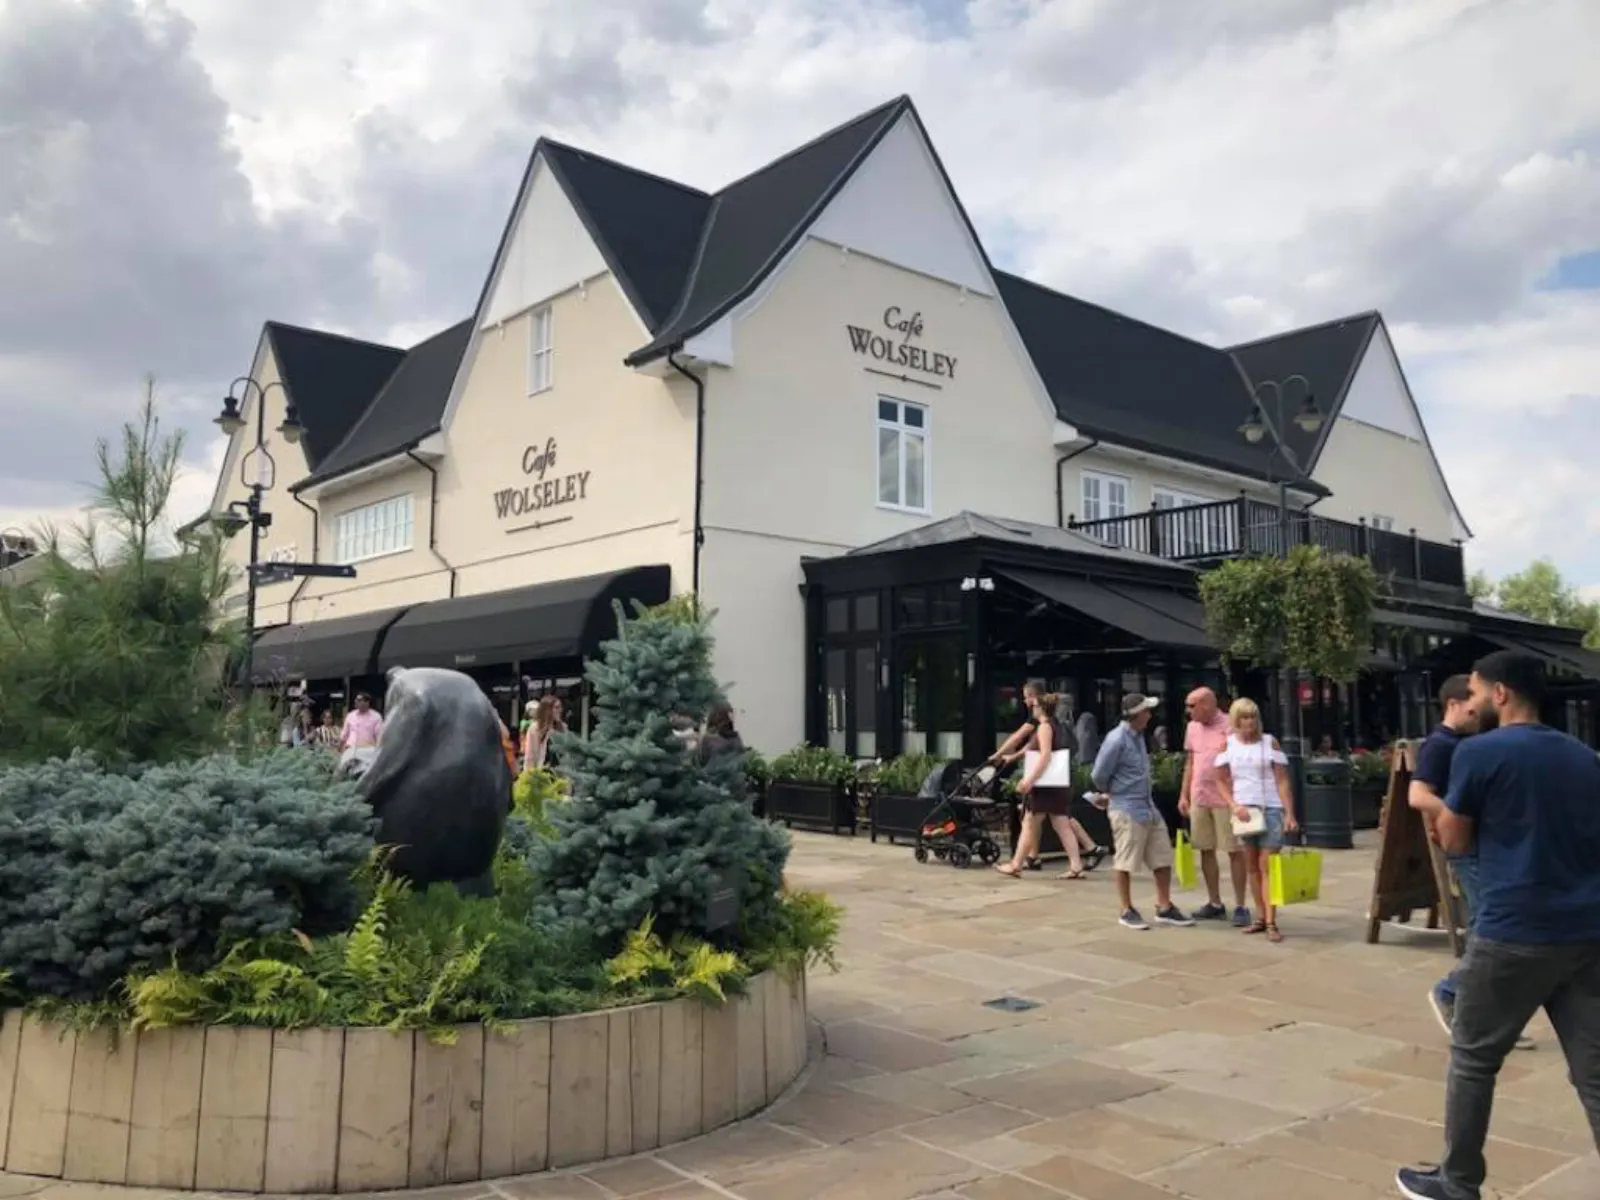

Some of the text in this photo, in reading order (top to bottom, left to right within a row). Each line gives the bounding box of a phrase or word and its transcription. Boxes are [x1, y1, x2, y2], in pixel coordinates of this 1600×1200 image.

[883, 305, 924, 343] Café
[846, 324, 958, 379] WOLSELEY
[522, 437, 557, 481] Café
[493, 470, 591, 519] WOLSELEY
